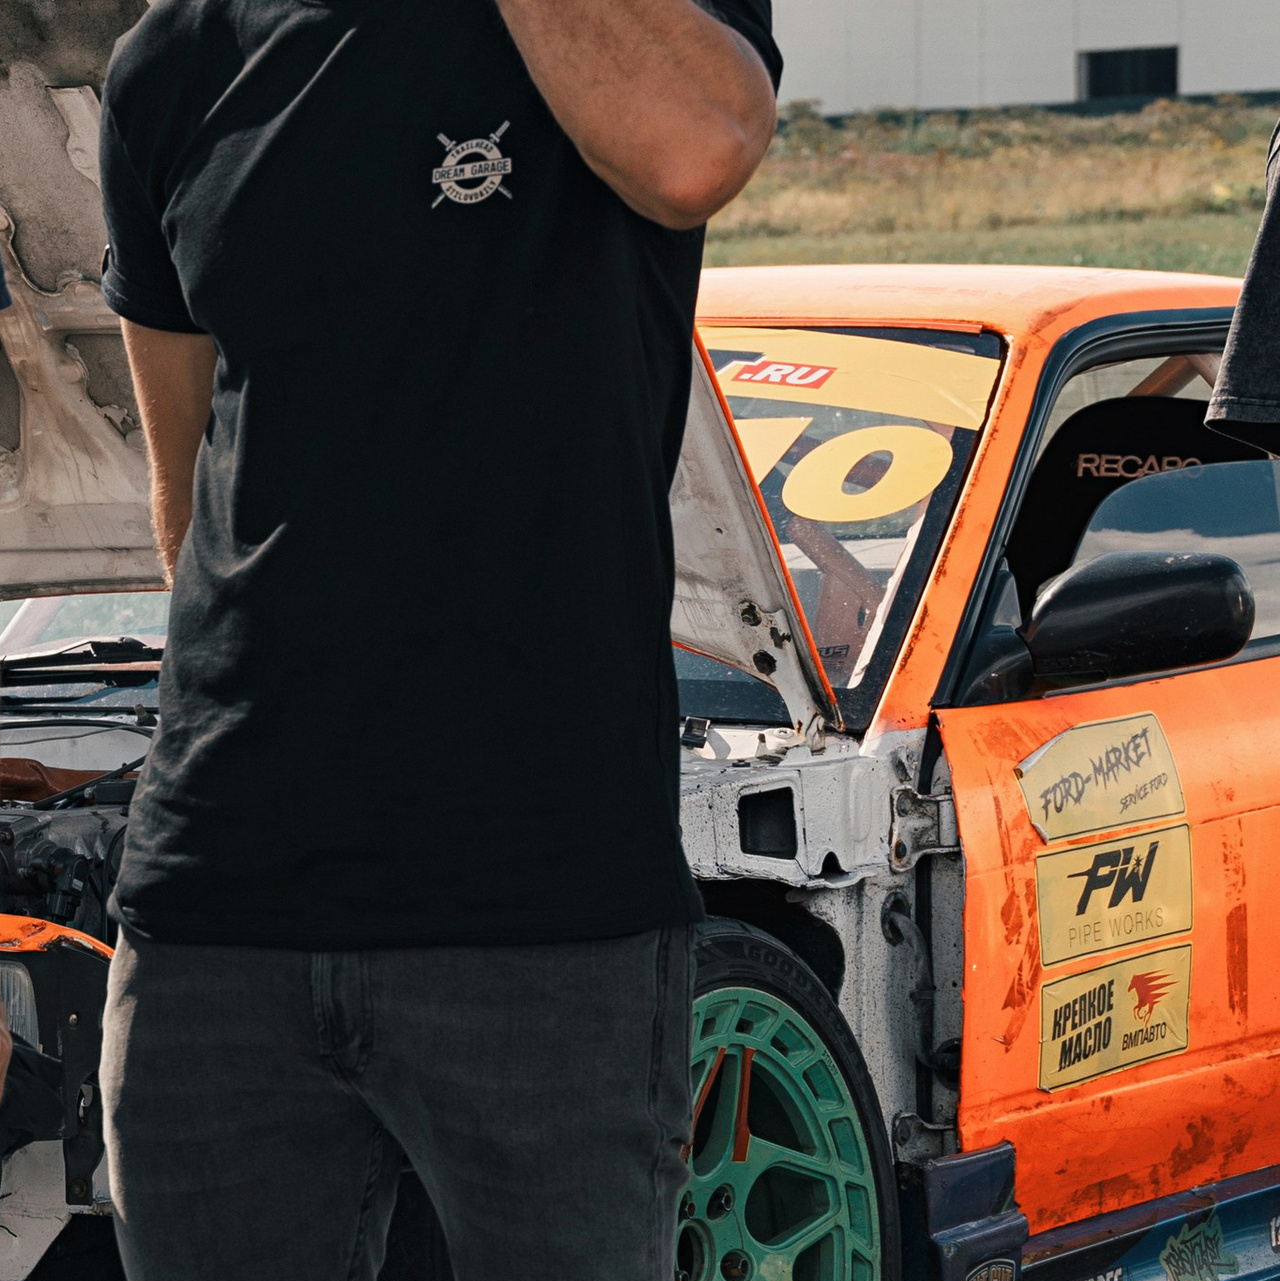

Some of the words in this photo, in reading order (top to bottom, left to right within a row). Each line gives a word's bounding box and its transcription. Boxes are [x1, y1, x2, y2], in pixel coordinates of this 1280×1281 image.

[434, 167, 465, 181] DREAM
[471, 160, 510, 176] GARAGE
[1039, 727, 1153, 822] FORD-MARKET
[1149, 772, 1169, 795] FORD
[1067, 841, 1160, 917] PW
[1068, 921, 1103, 949] PIPE
[1108, 907, 1165, 938] WORKS
[1051, 979, 1115, 1041] КРЕПКОЕ
[1058, 1016, 1113, 1072] МАСЛО
[1121, 1022, 1167, 1051] ВМПАВТО
